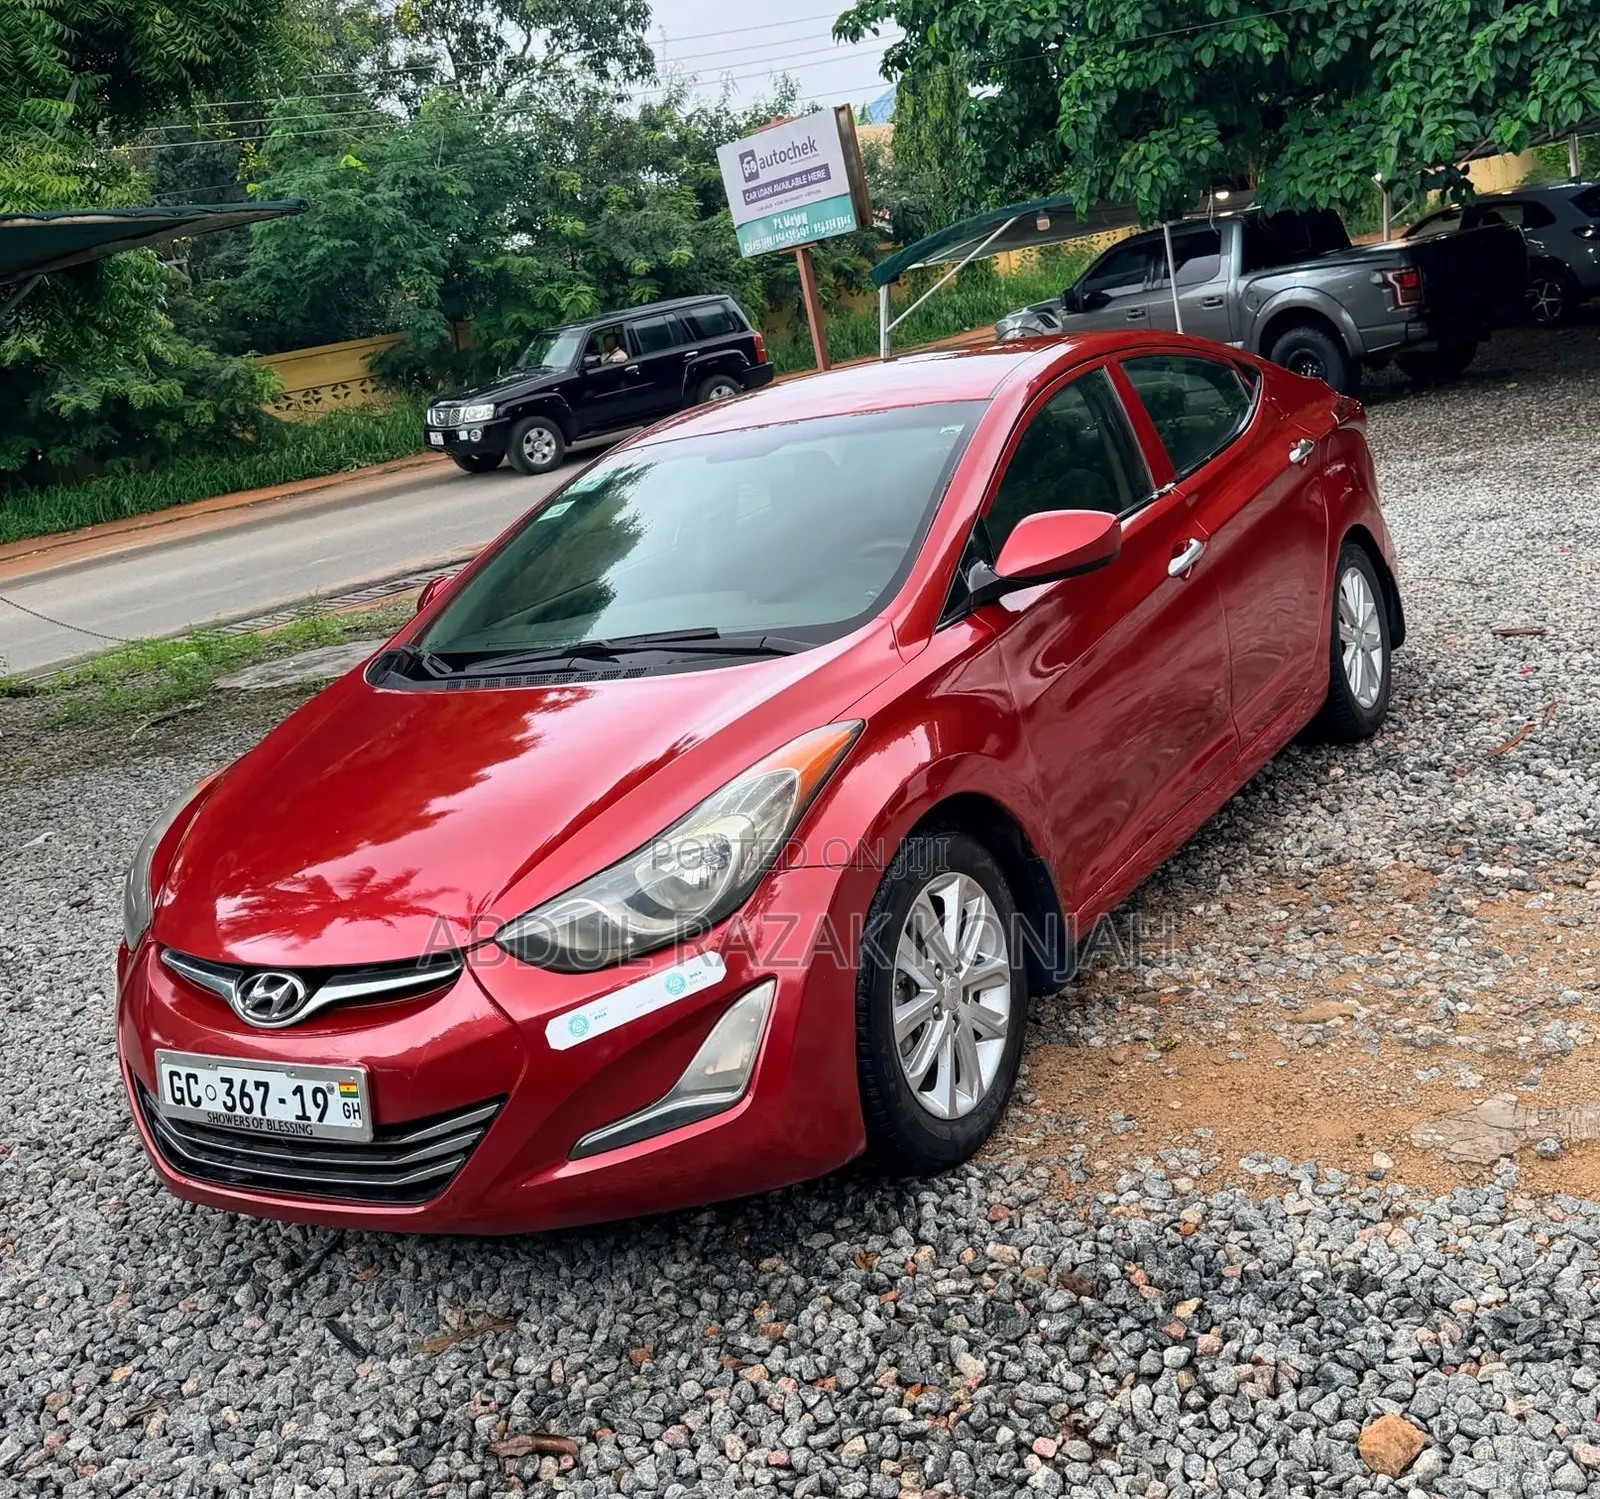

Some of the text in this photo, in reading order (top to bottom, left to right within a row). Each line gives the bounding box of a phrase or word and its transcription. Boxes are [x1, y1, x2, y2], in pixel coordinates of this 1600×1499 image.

[759, 135, 818, 170] autochek
[745, 190, 757, 201] CAR
[757, 185, 773, 198] LOAN
[773, 174, 808, 193] AVAILABLE
[807, 168, 827, 183] HERE
[168, 1070, 202, 1108] GC
[207, 1112, 313, 1136] SHOWERS OF BLESSING
[342, 1101, 362, 1120] GH
